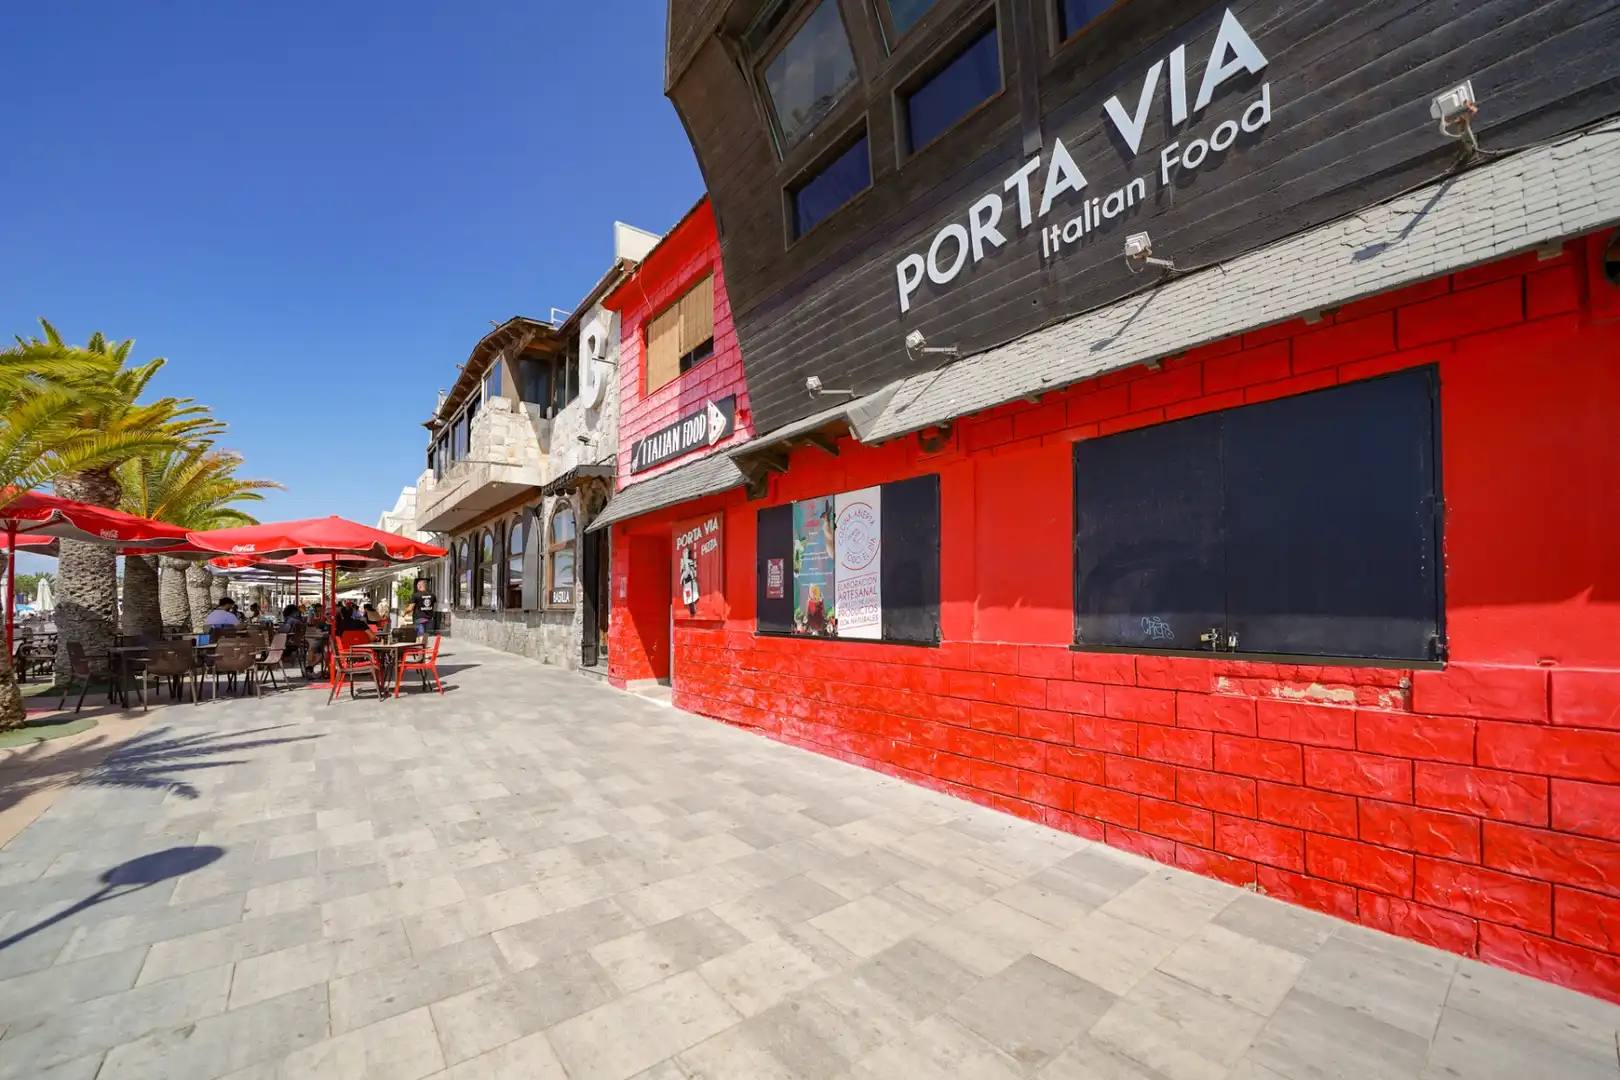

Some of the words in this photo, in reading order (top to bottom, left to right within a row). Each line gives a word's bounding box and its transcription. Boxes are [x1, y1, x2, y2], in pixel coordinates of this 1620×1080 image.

[896, 137, 1088, 313] PORTA
[1103, 8, 1269, 156] VIA
[1042, 177, 1146, 258] Italian
[1161, 82, 1272, 185] Food
[579, 320, 604, 410] B
[642, 425, 680, 466] ITALIAN
[682, 414, 706, 449] FOOD
[676, 526, 703, 551] PORTA
[704, 516, 719, 535] VIA
[838, 585, 878, 602] ARTESANAL
[838, 603, 878, 618] PRODUCTOS
